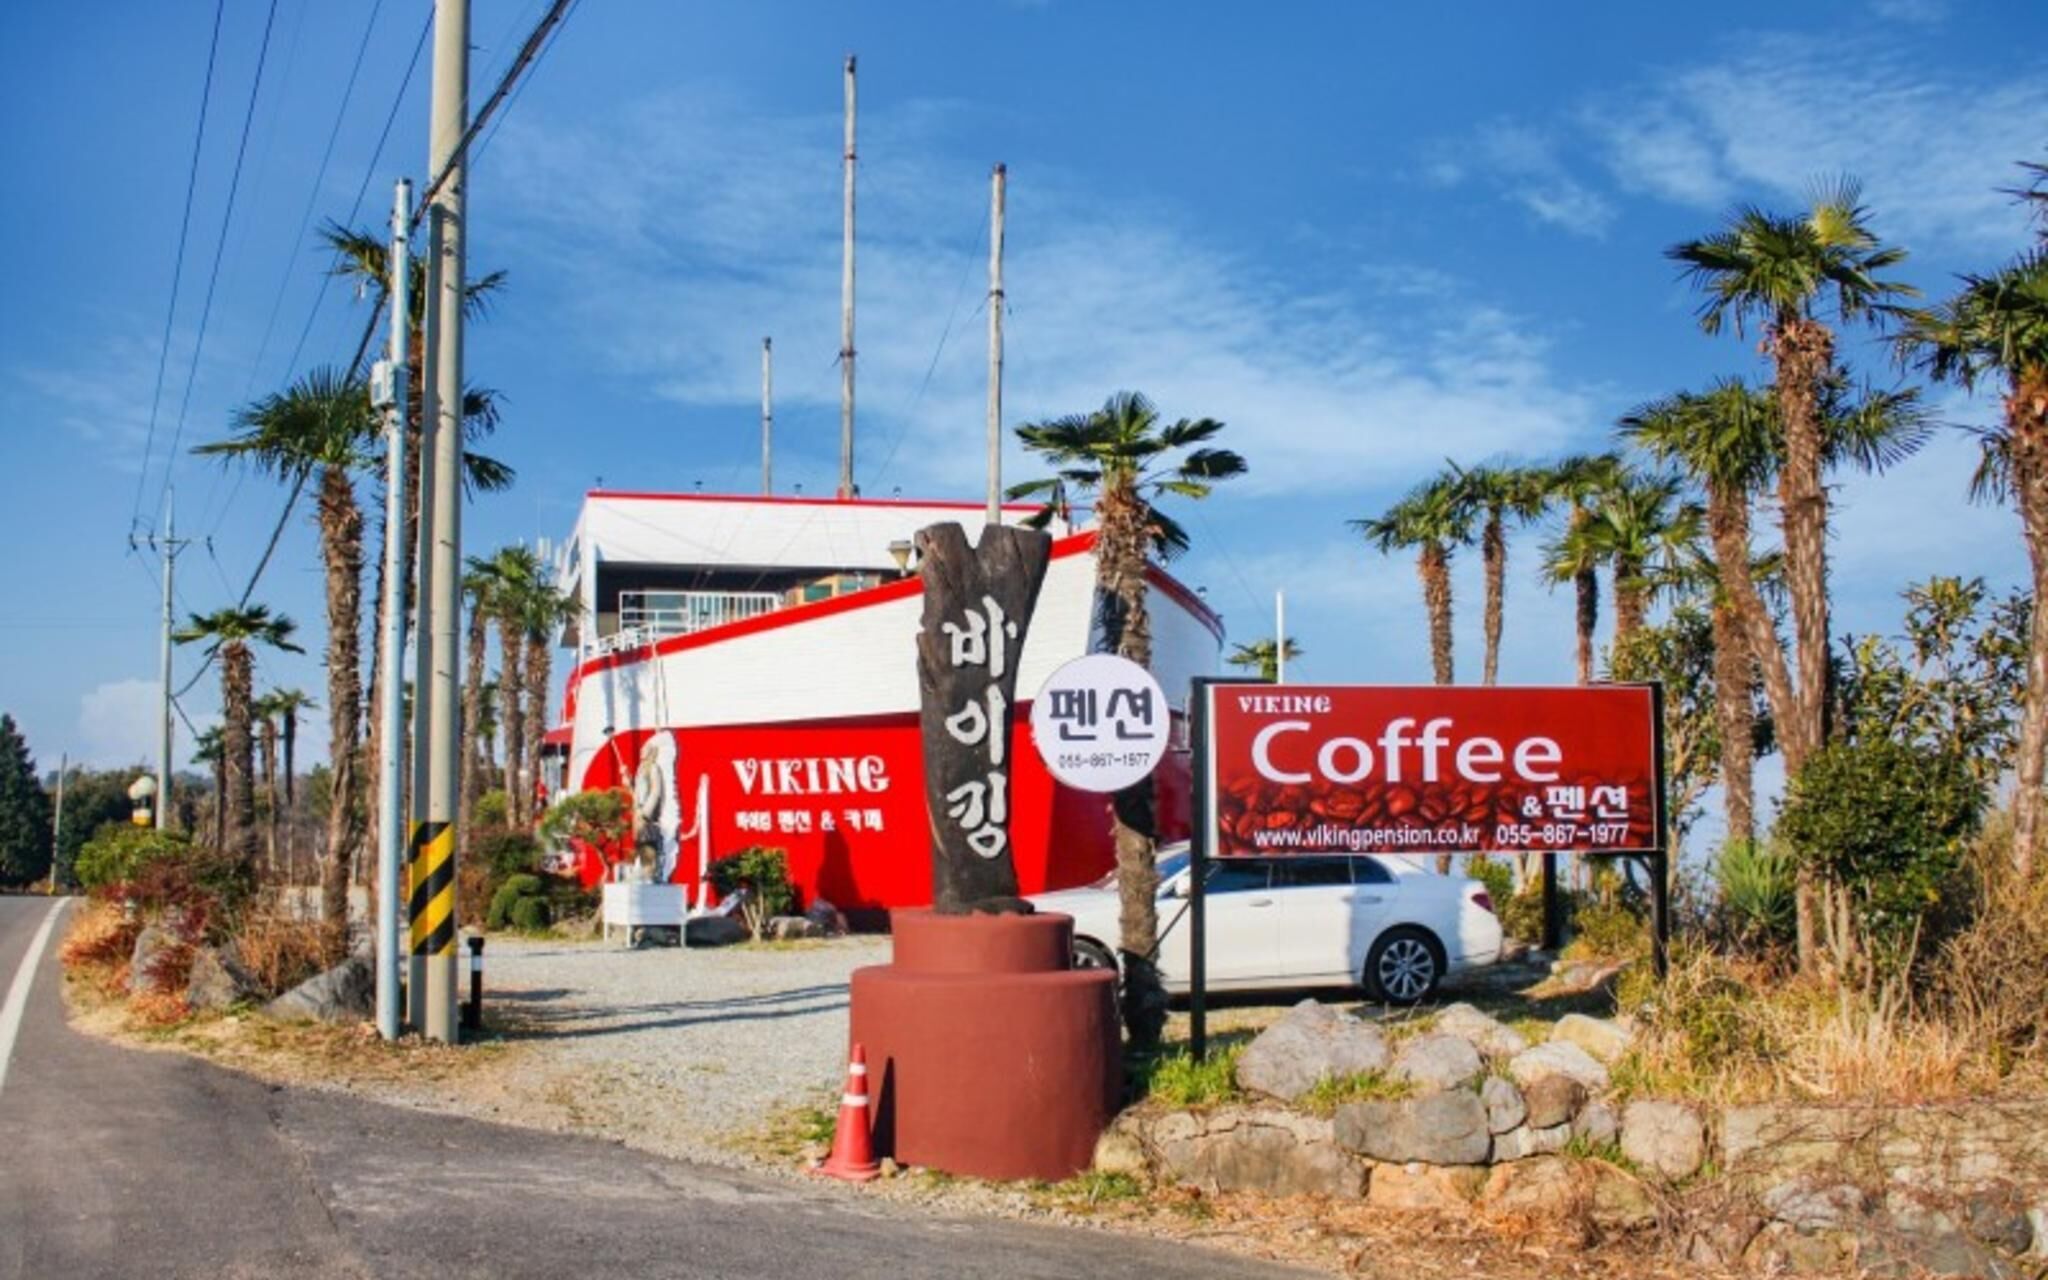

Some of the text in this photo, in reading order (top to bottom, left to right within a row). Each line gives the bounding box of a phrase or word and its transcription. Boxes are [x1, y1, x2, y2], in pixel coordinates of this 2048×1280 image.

[1049, 687, 1155, 742] 펜션
[1238, 695, 1332, 714] VIKING
[942, 595, 1018, 859] 바이킹
[1251, 717, 1563, 784] Coffee
[731, 755, 891, 795] VIKING
[820, 809, 835, 831] &
[1254, 823, 1629, 851] www.vikingpension.co.kr 055-867-1977
